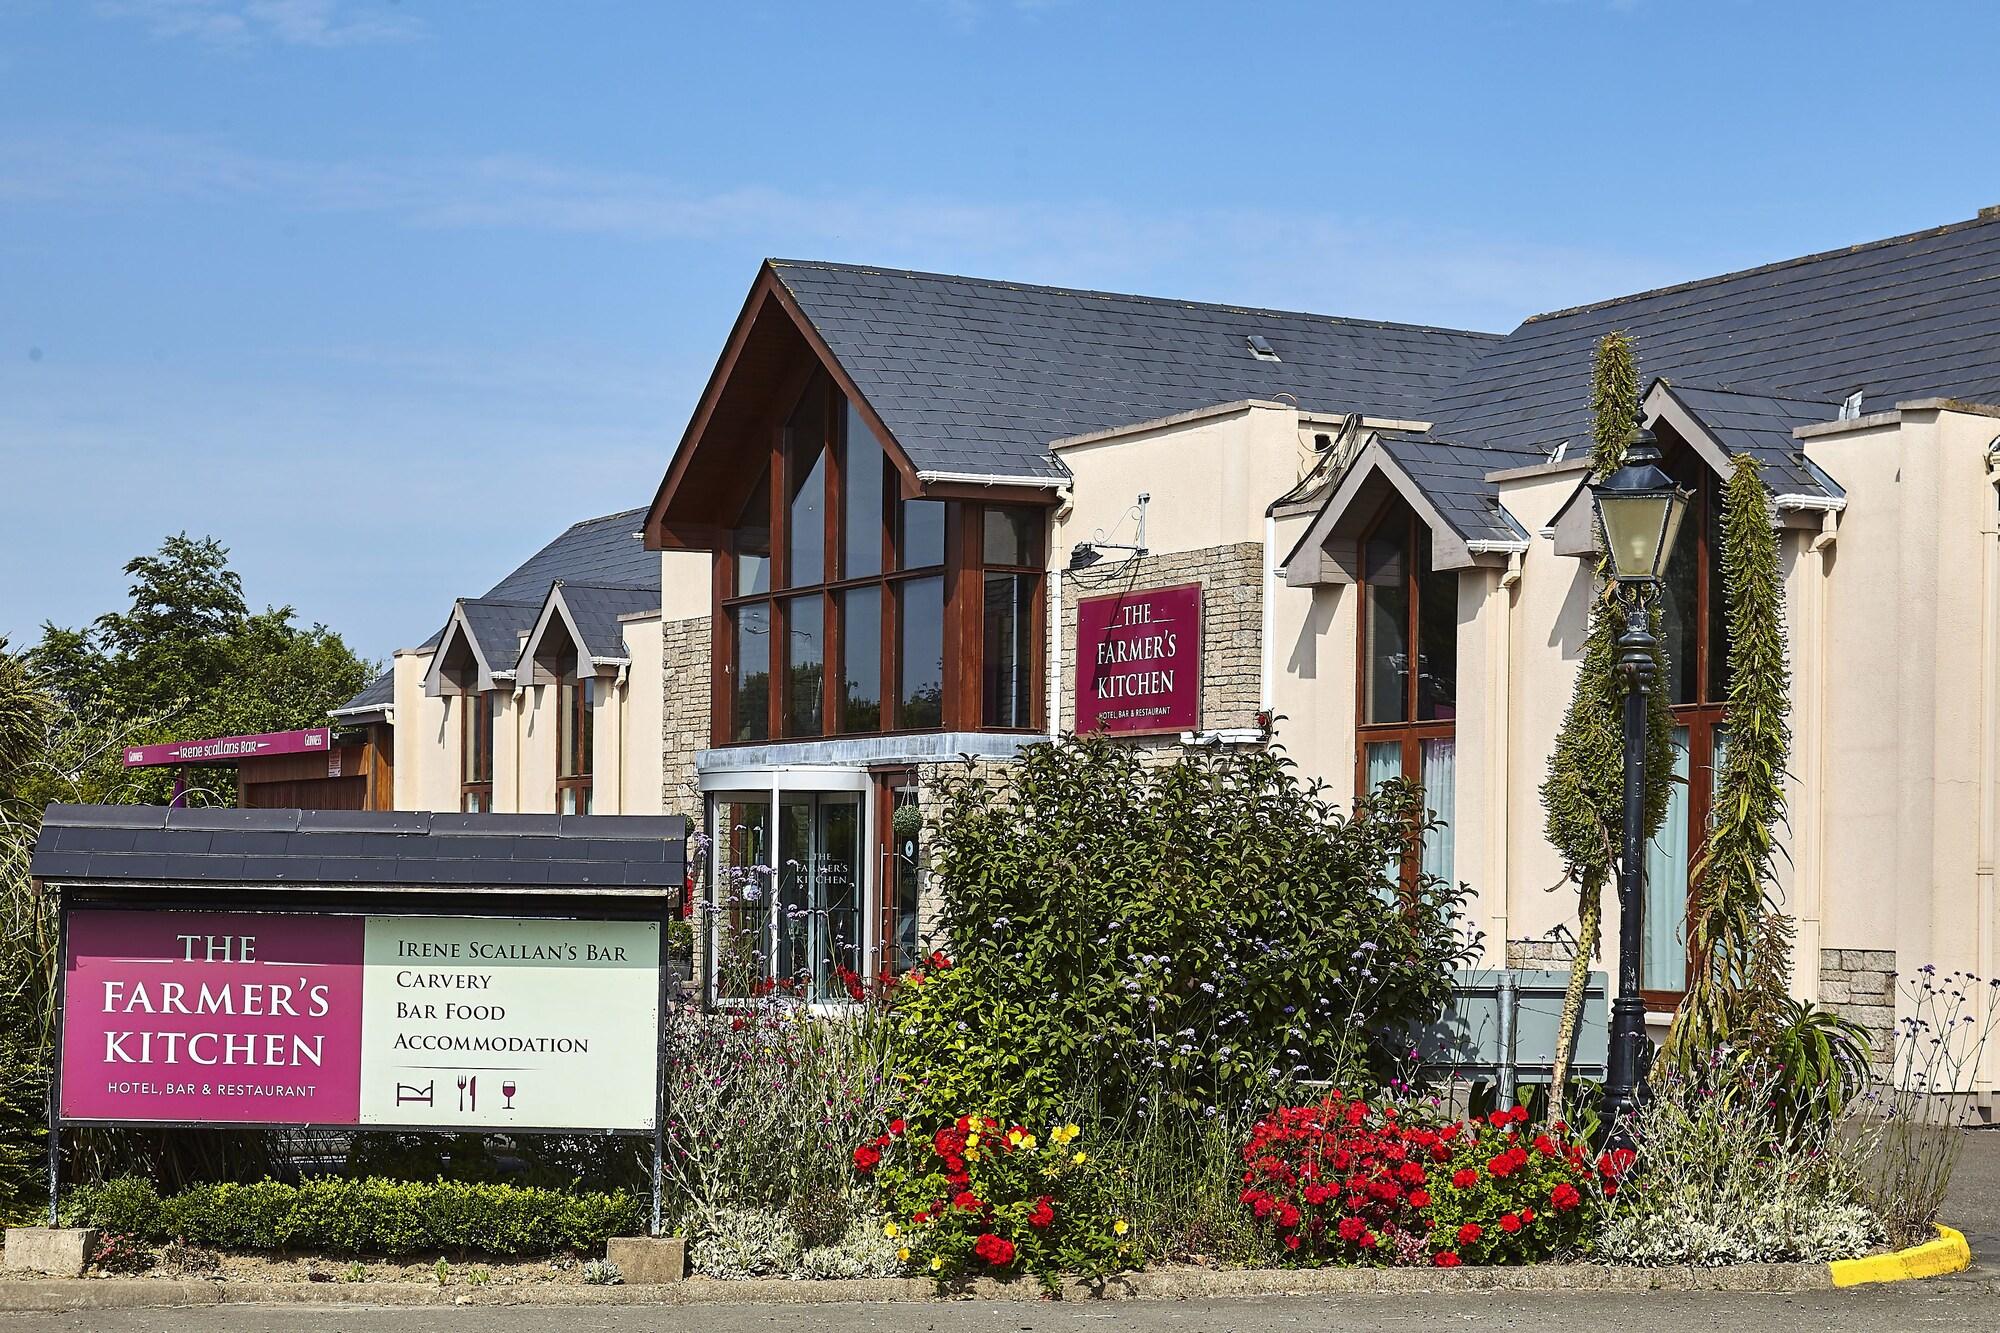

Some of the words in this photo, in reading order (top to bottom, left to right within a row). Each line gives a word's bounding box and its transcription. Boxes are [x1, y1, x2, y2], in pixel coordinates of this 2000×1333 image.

[1123, 603, 1151, 626] THE
[1097, 629, 1177, 665] FARMER'S
[1097, 670, 1175, 700] KITCHEN
[1135, 706, 1171, 717] RESTAURANT
[177, 935, 256, 964] THE
[398, 940, 461, 958] IRENE
[469, 941, 577, 961] SCALLAN'S
[586, 944, 628, 962] BAR
[396, 971, 493, 989] CARVERY
[102, 977, 330, 1017] FARMER'S
[396, 1002, 437, 1020] BAR
[446, 1003, 506, 1021] FOOD
[103, 1031, 325, 1067] KITCHEN
[394, 1033, 589, 1053] ACCOMMODATION
[166, 1083, 195, 1096] BAR
[202, 1084, 212, 1096] &
[218, 1084, 316, 1097] RESTAURANT
